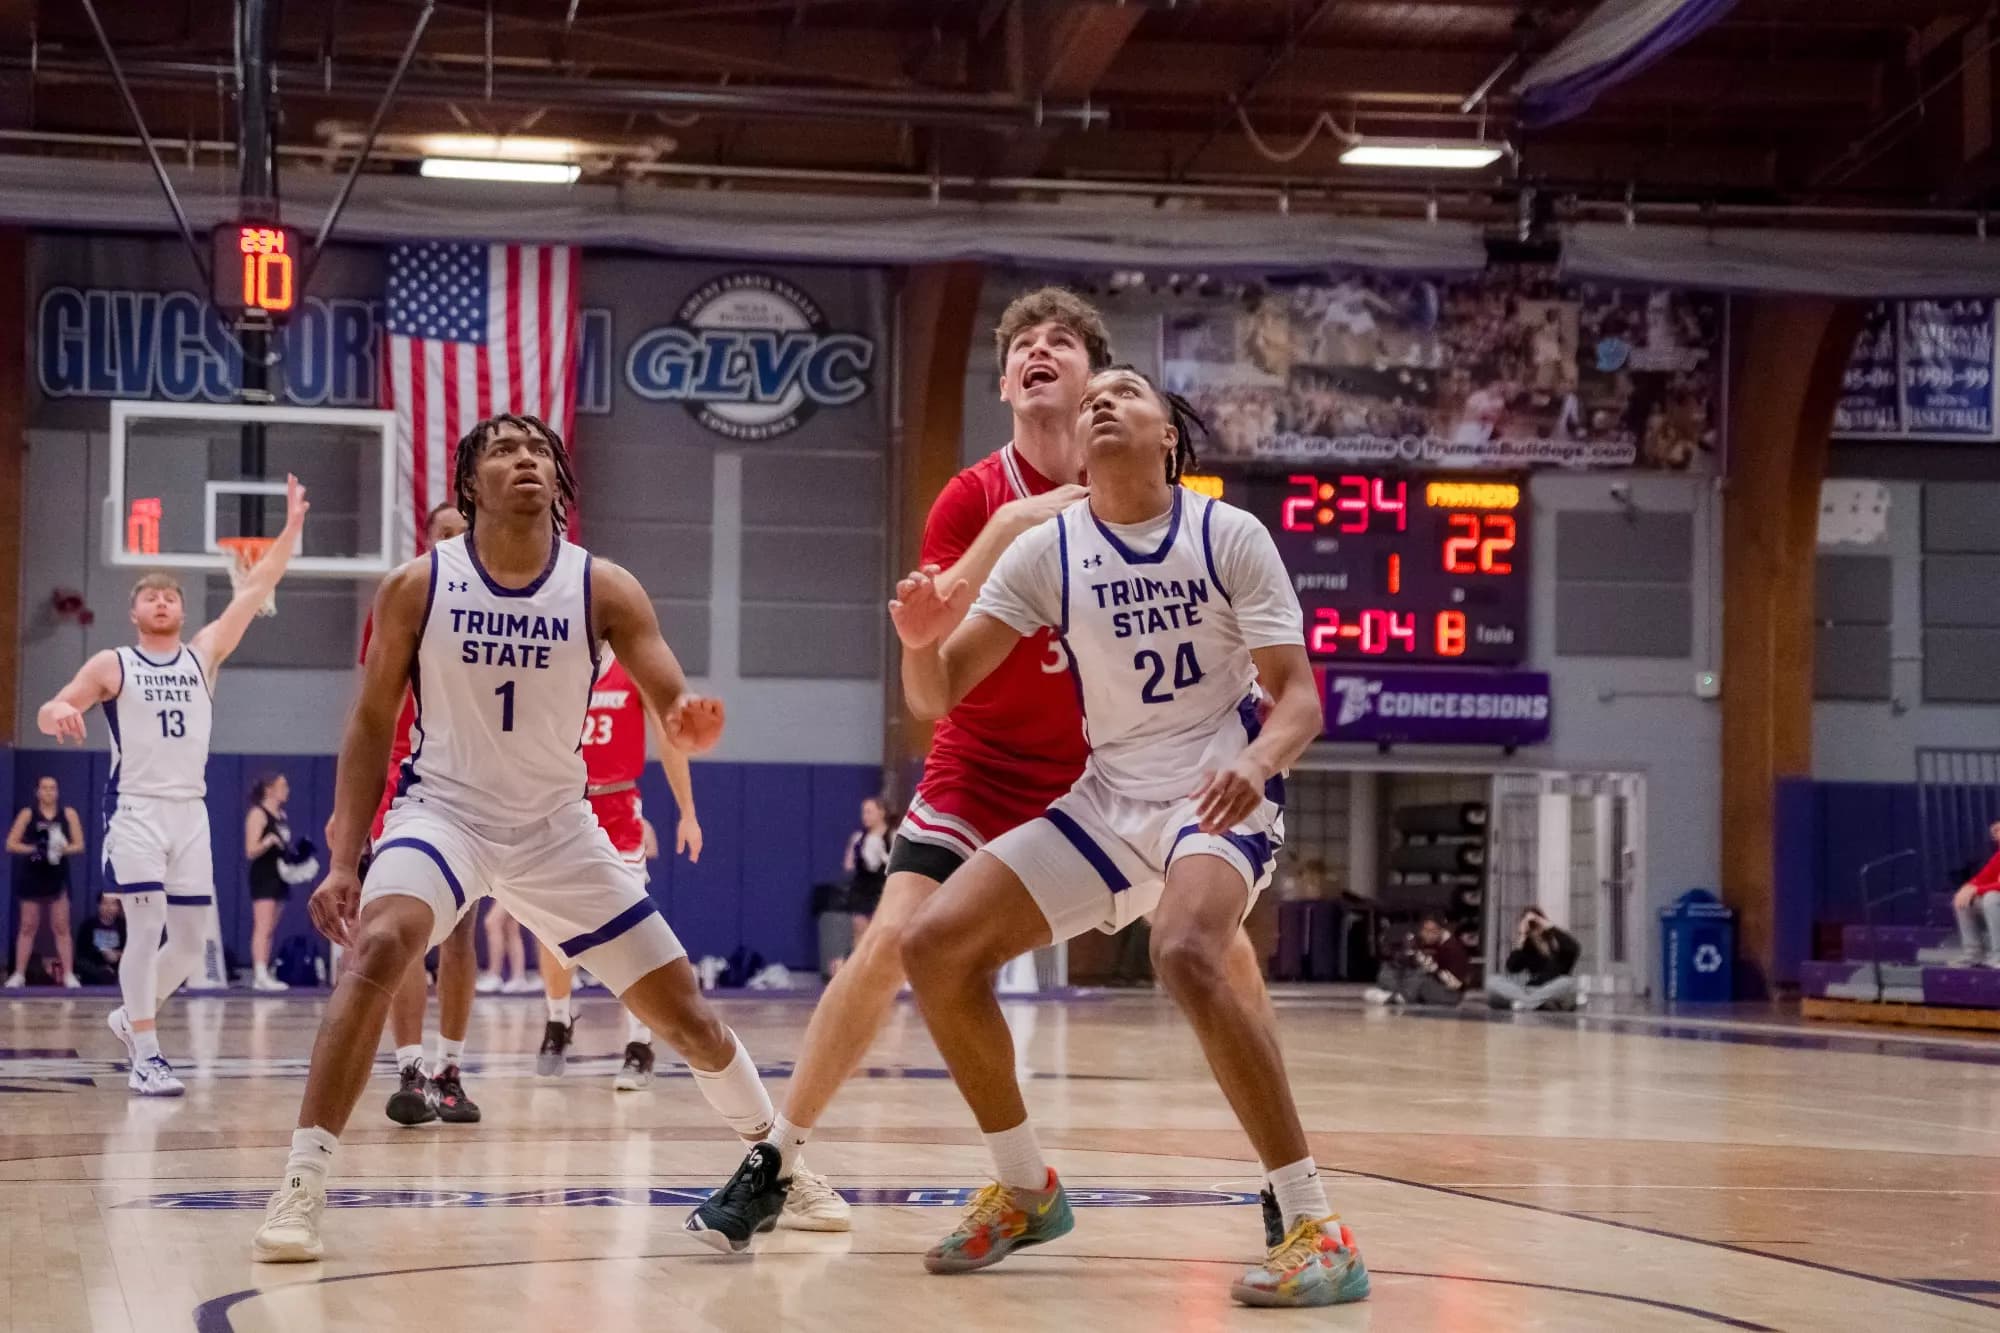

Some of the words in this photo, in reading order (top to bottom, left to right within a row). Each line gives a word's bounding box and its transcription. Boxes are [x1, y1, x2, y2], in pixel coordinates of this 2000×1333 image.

[244, 253, 292, 309] 10
[626, 326, 873, 405] GLVC
[1283, 474, 1407, 533] 2:34
[1443, 513, 1516, 574] 22
[1295, 574, 1348, 592] period
[1386, 552, 1400, 594] 1
[1091, 576, 1209, 609] TRUMAN
[450, 609, 569, 641] TRUMAN
[1112, 603, 1203, 638] STATE
[461, 640, 552, 669] STATE
[134, 674, 199, 687] TRUMAN
[1133, 641, 1206, 704] 24
[144, 689, 192, 703] STATE
[494, 680, 515, 732] 1
[1378, 692, 1548, 720] CONCESSIONS
[156, 709, 186, 738] 13
[581, 714, 613, 745] 23
